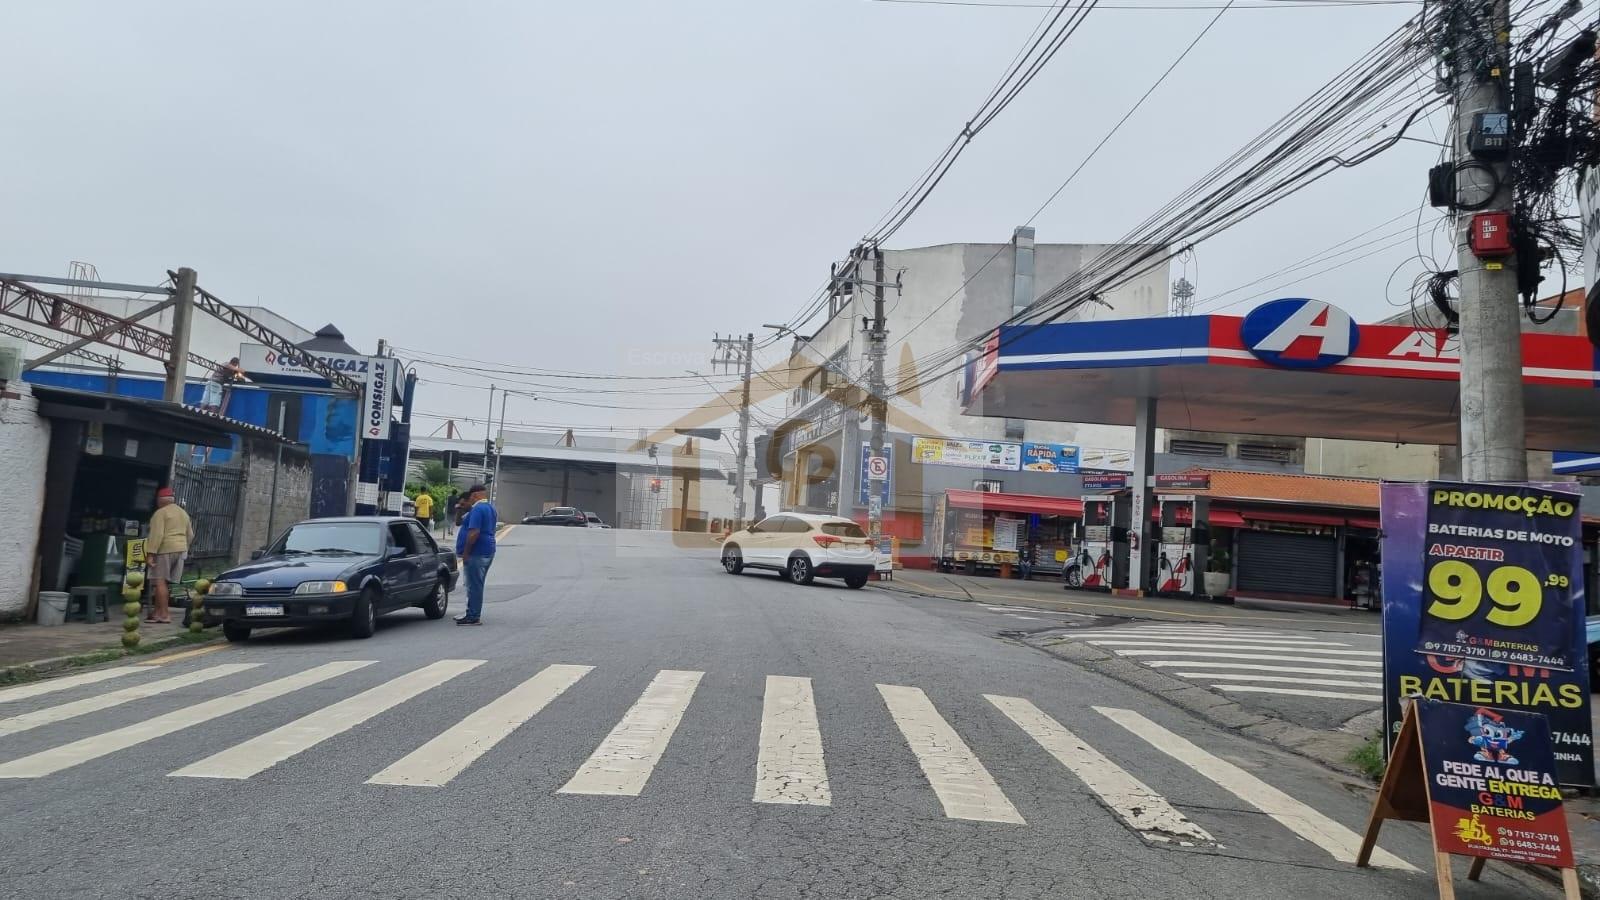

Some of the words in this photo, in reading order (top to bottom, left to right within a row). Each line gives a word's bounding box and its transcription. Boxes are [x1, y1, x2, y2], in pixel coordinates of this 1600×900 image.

[371, 361, 385, 427] CONSIGAZ
[1433, 490, 1574, 517] PROMOÇÃO
[1429, 523, 1504, 539] BATERIAS
[1506, 530, 1527, 542] DE
[1530, 532, 1574, 547] MOTO
[1429, 543, 1445, 556] A
[1444, 544, 1505, 562] PARTIR
[1427, 560, 1543, 627] 99
[1442, 643, 1486, 656] 7157-3710
[1510, 652, 1564, 665] 6483-7444
[1400, 675, 1583, 709] BATERIAS
[1443, 760, 1482, 777] PEDE
[1506, 769, 1540, 785] QUE
[1542, 772, 1555, 786] A
[1436, 773, 1487, 792] GENTE
[1489, 780, 1562, 801] ENTREGA
[1471, 804, 1536, 821] BATERIAS
[1507, 829, 1513, 837] 9
[1514, 830, 1559, 842] 7157-3710
[1509, 839, 1515, 847] 9
[1516, 840, 1561, 852] 6483-7444
